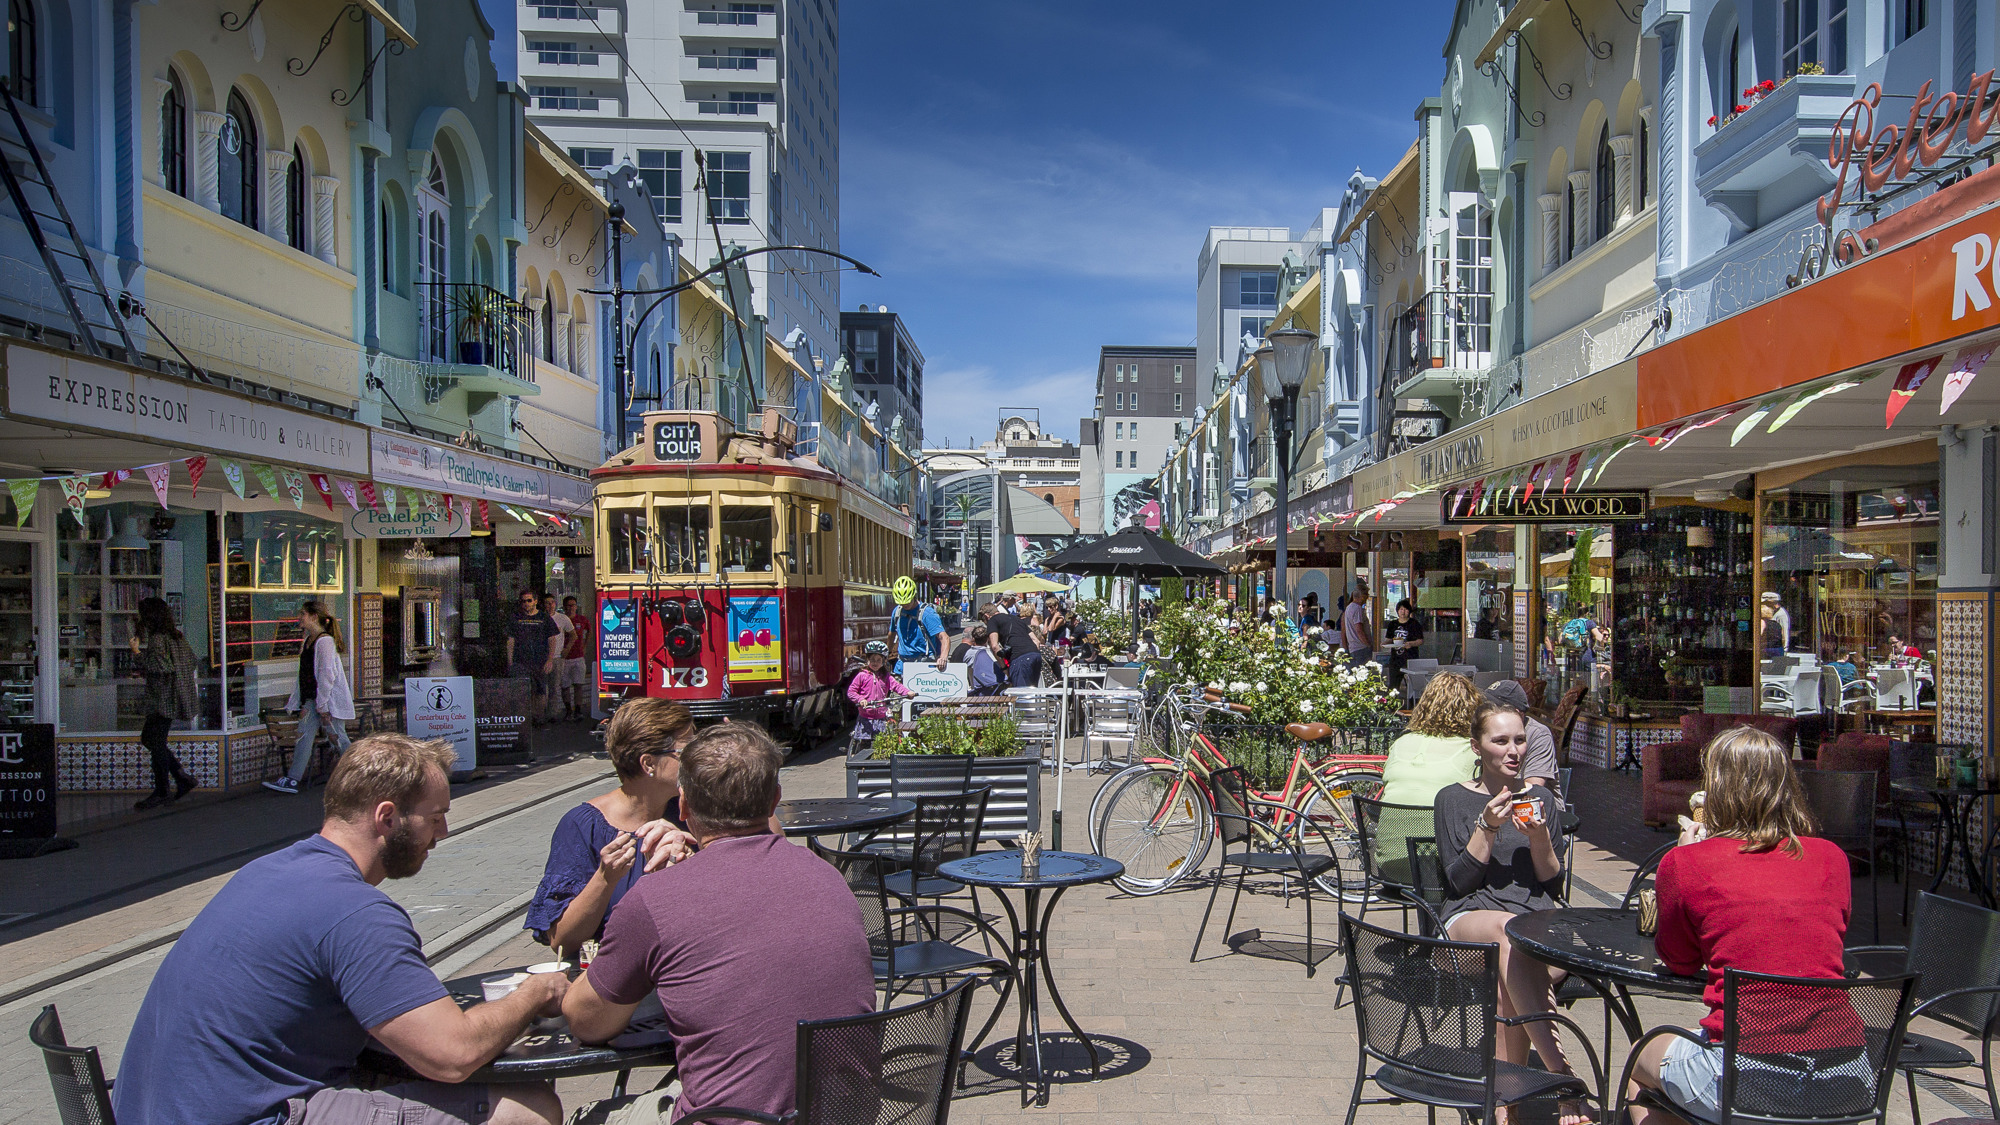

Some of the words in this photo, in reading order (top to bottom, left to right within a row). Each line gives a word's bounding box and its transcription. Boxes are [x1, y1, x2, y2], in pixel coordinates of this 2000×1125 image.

[1816, 68, 2000, 225] Peter
[1951, 232, 2000, 321] R
[48, 375, 189, 424] EXPRESSION
[208, 409, 268, 441] TATTOO
[278, 427, 286, 445] &
[297, 430, 352, 459] GALLERY
[1542, 408, 1574, 434] COCKTAIL
[1577, 396, 1607, 423] LOUNGE
[660, 425, 696, 438] CITY
[656, 441, 701, 454] TOUR
[447, 456, 501, 494] Penelope's
[503, 475, 524, 498] Cakery
[525, 480, 538, 496] Deli
[1515, 498, 1558, 515] LAST
[1564, 498, 1626, 515] WORD.
[367, 508, 450, 526] Penelope's
[379, 526, 412, 536] Cakery
[415, 526, 435, 535] Deli
[661, 667, 709, 688] 178
[916, 678, 958, 688] Penelope's
[414, 713, 449, 722] Canterbury
[450, 713, 466, 721] Cake
[428, 723, 454, 731] Supplies
